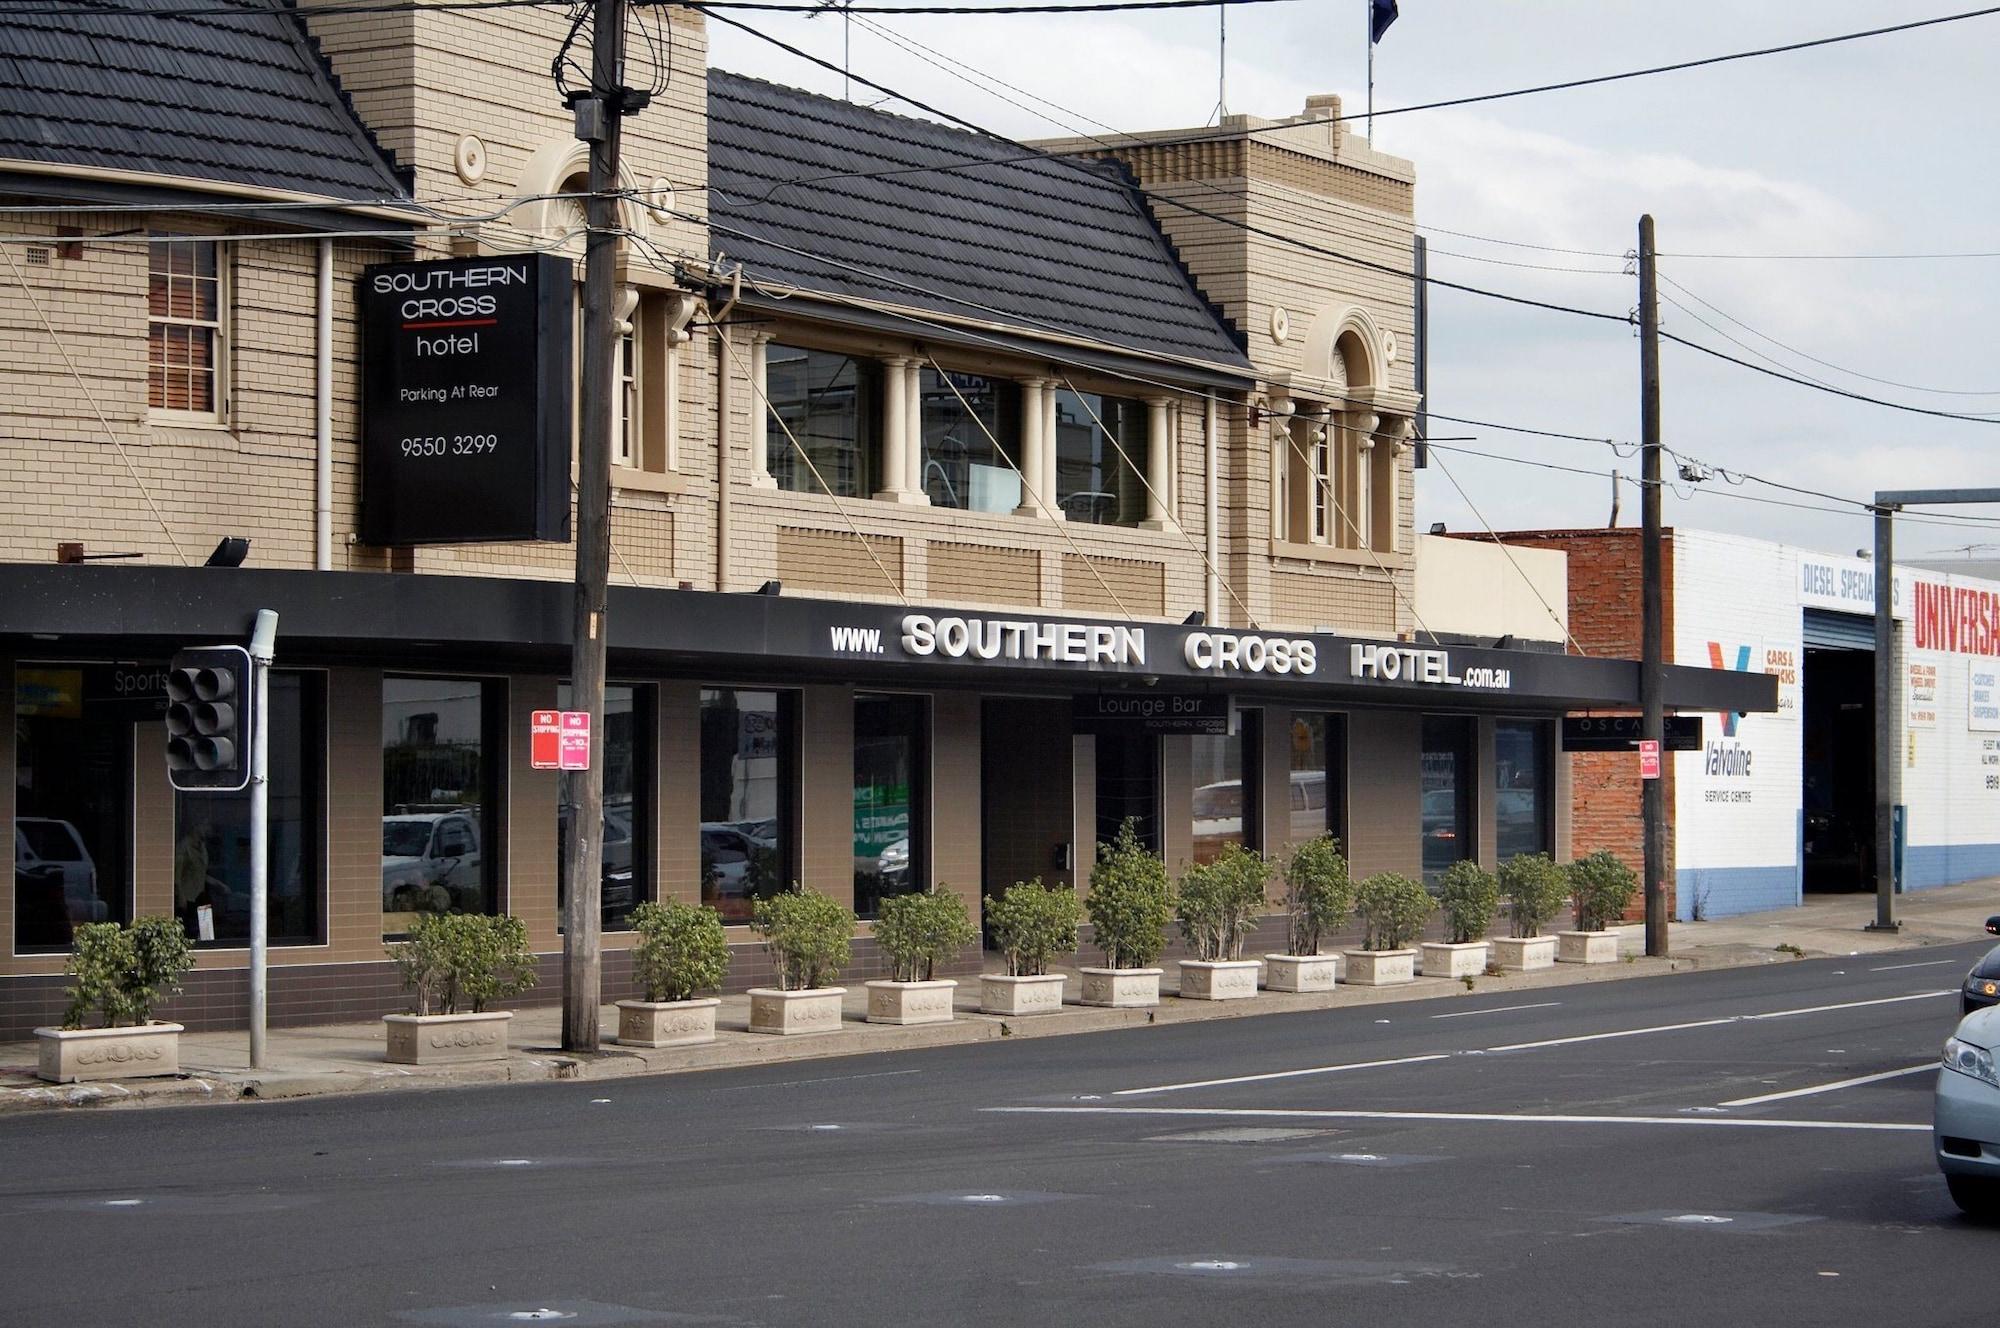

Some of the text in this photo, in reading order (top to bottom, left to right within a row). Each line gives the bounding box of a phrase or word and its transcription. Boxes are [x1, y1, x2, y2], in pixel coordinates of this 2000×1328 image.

[374, 266, 527, 293] SOUTHERN
[401, 296, 496, 319] CROSS
[416, 333, 478, 356] hotel
[401, 384, 498, 402] Parking At Rear
[401, 435, 497, 457] 9550 3299
[1803, 563, 1836, 597] DIESEL
[901, 614, 1145, 665] SOUTHERN
[1185, 632, 1316, 675] CROSS
[1351, 643, 1461, 684] HOTEL
[1463, 666, 1510, 689] .com.au
[1766, 649, 1788, 666] CARS
[115, 669, 169, 696] Sports
[1099, 695, 1202, 717] Lounge Bar
[540, 714, 552, 724] NO
[569, 718, 582, 726] NO
[1581, 720, 1672, 731] OSCAS
[1705, 740, 1752, 777] Valvoline
[1704, 790, 1752, 803] SERVICE CENTRE
